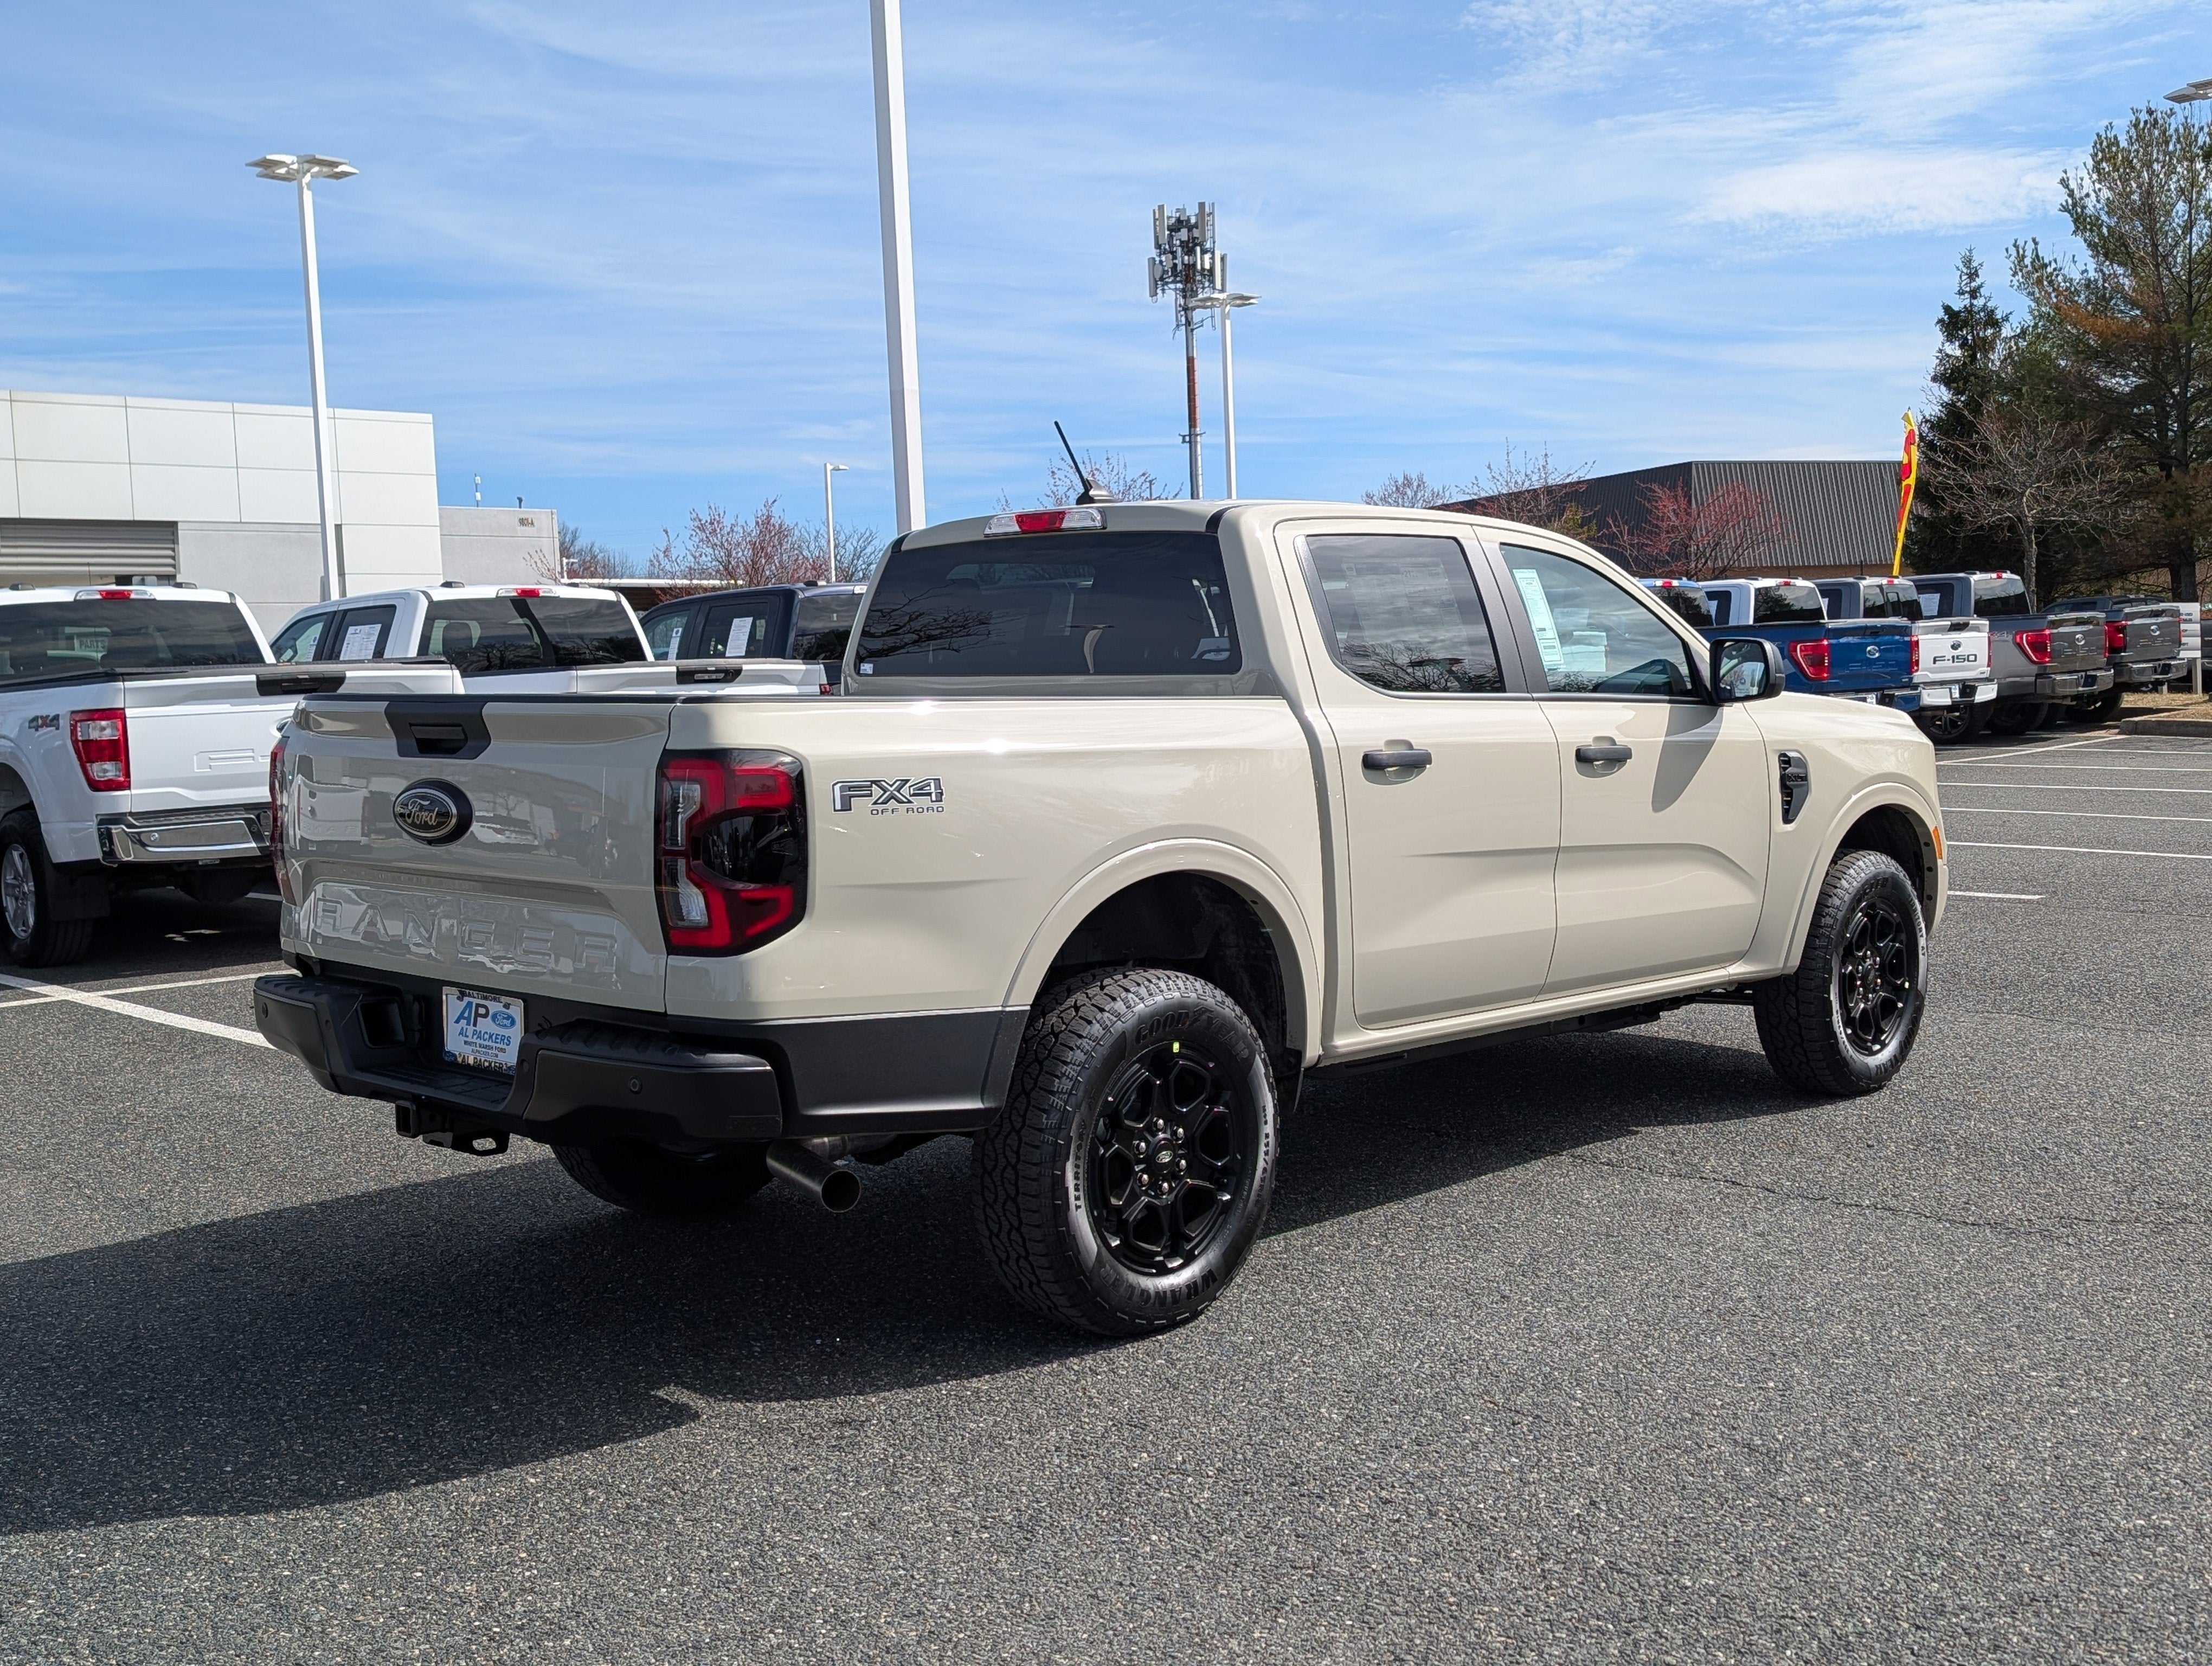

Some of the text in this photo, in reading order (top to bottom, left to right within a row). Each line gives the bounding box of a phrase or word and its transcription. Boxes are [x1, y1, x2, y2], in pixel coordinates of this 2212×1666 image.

[1933, 653, 1978, 665] F-150
[832, 777, 945, 812] FX4
[407, 798, 438, 826] Ford
[870, 806, 945, 816] OFF ROAD
[313, 898, 617, 974] RANGER
[462, 990, 503, 1003] BALTIMORE
[453, 1001, 511, 1028] AP Ford
[458, 1027, 512, 1047] AL PACKERS
[1135, 1006, 1250, 1062] GOODYEAR
[1099, 1265, 1219, 1308] WRANGLER
